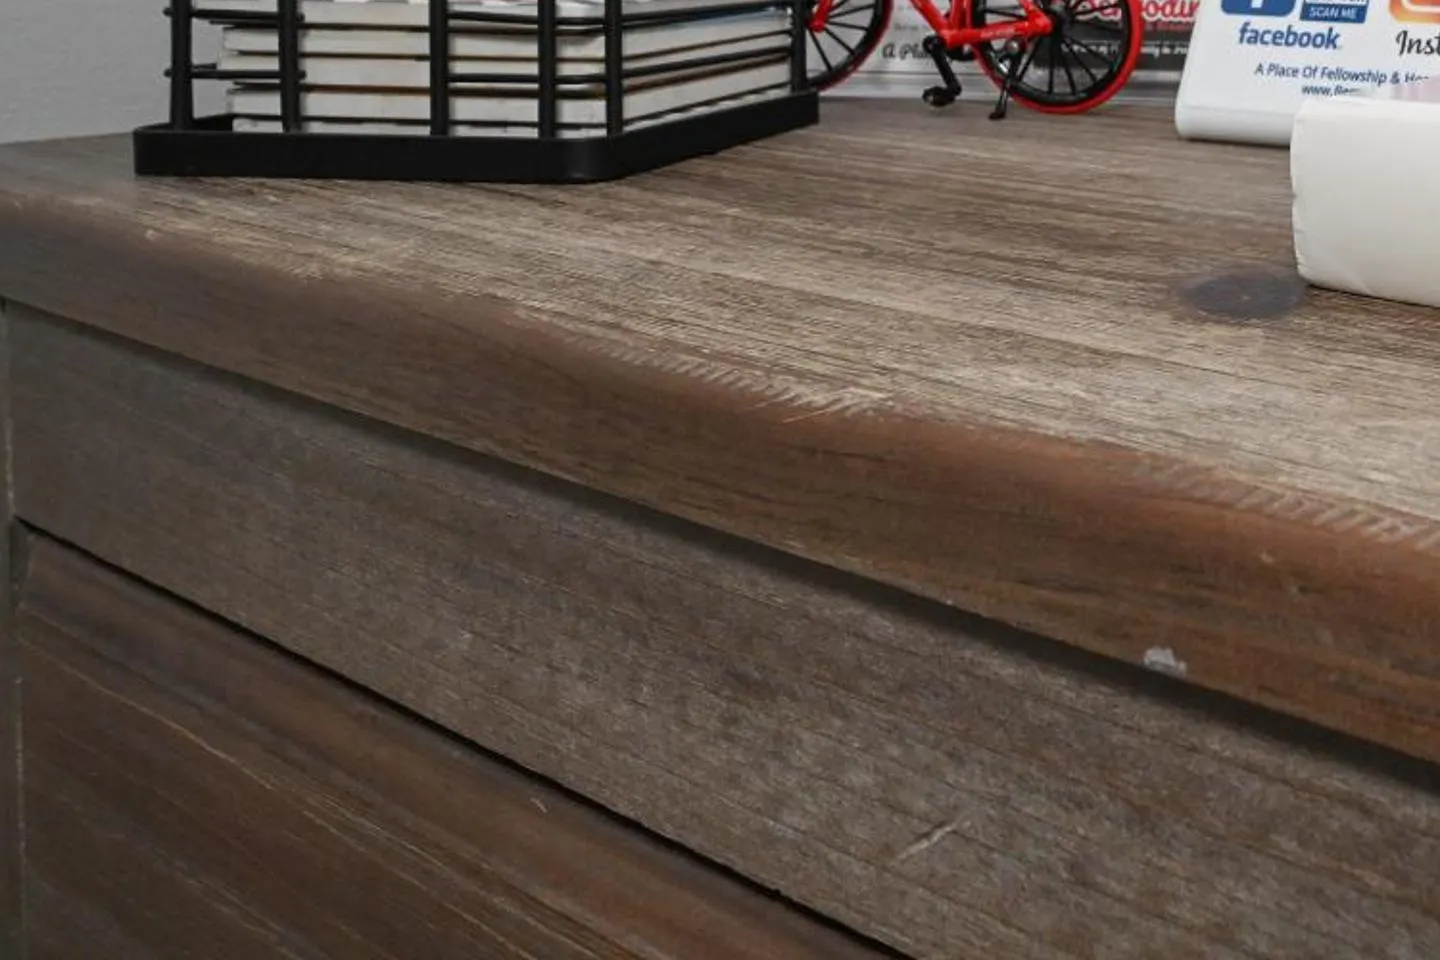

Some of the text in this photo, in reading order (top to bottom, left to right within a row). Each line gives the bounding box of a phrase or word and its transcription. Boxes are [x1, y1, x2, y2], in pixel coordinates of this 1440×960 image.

[1308, 6, 1358, 19] SCAN ME
[1239, 22, 1340, 50] facebook
[1254, 63, 1265, 75] A
[1267, 63, 1298, 77] Place
[1303, 65, 1319, 79] Of
[1320, 67, 1388, 87] Fellowship
[1391, 71, 1402, 84] &
